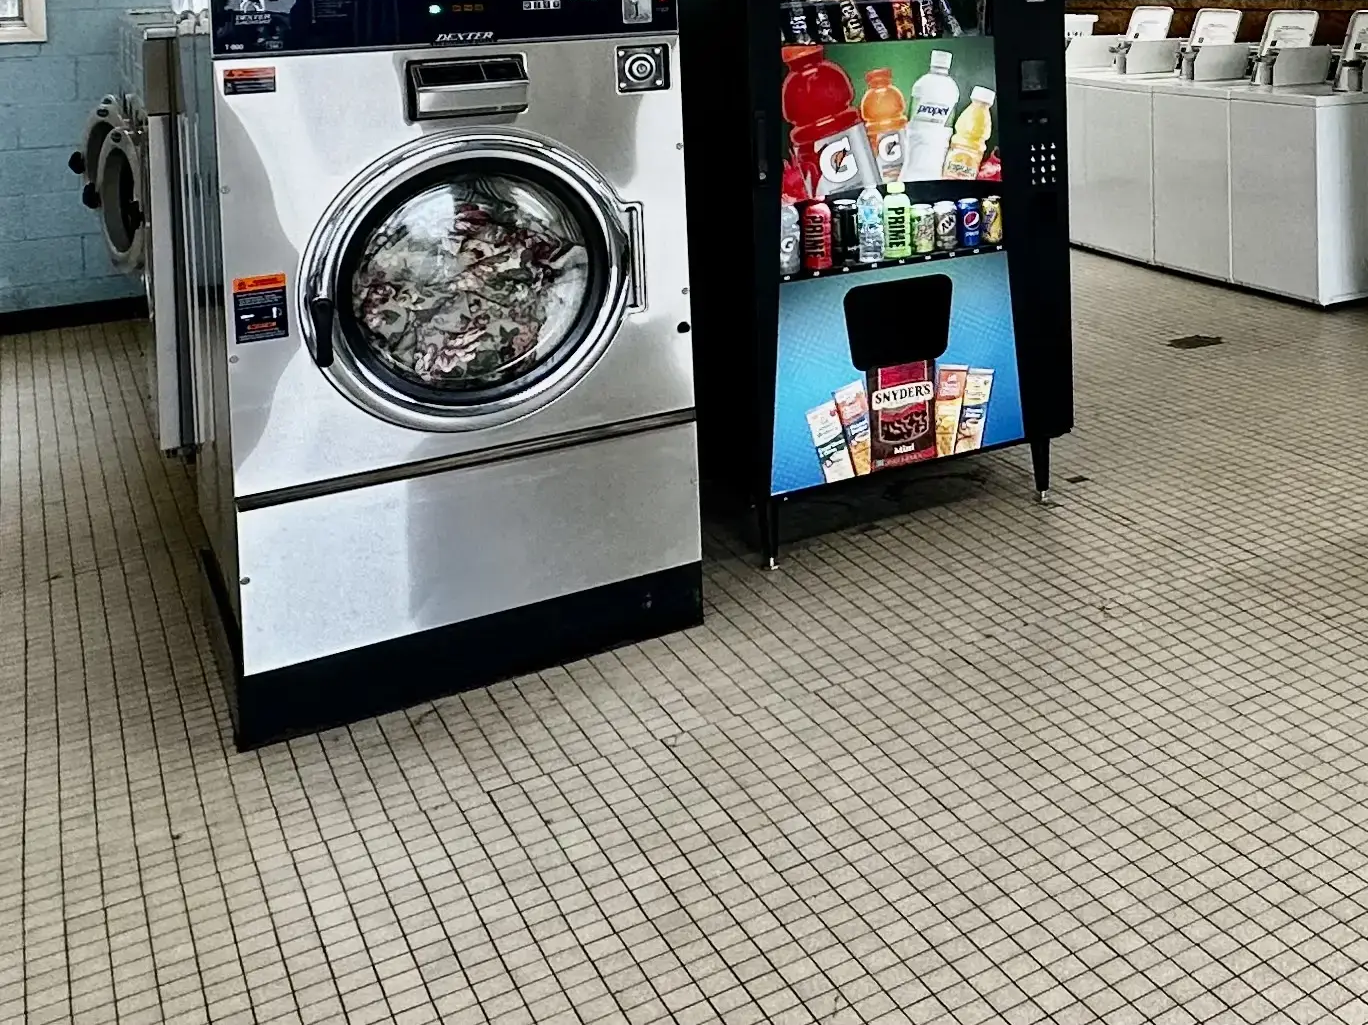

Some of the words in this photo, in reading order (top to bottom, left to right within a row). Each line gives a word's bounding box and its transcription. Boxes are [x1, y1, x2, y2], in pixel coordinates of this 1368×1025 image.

[435, 31, 494, 42] DEXTER
[804, 215, 825, 259] PRIME
[888, 207, 905, 248] PRIME
[875, 382, 932, 405] SNYDER'S
